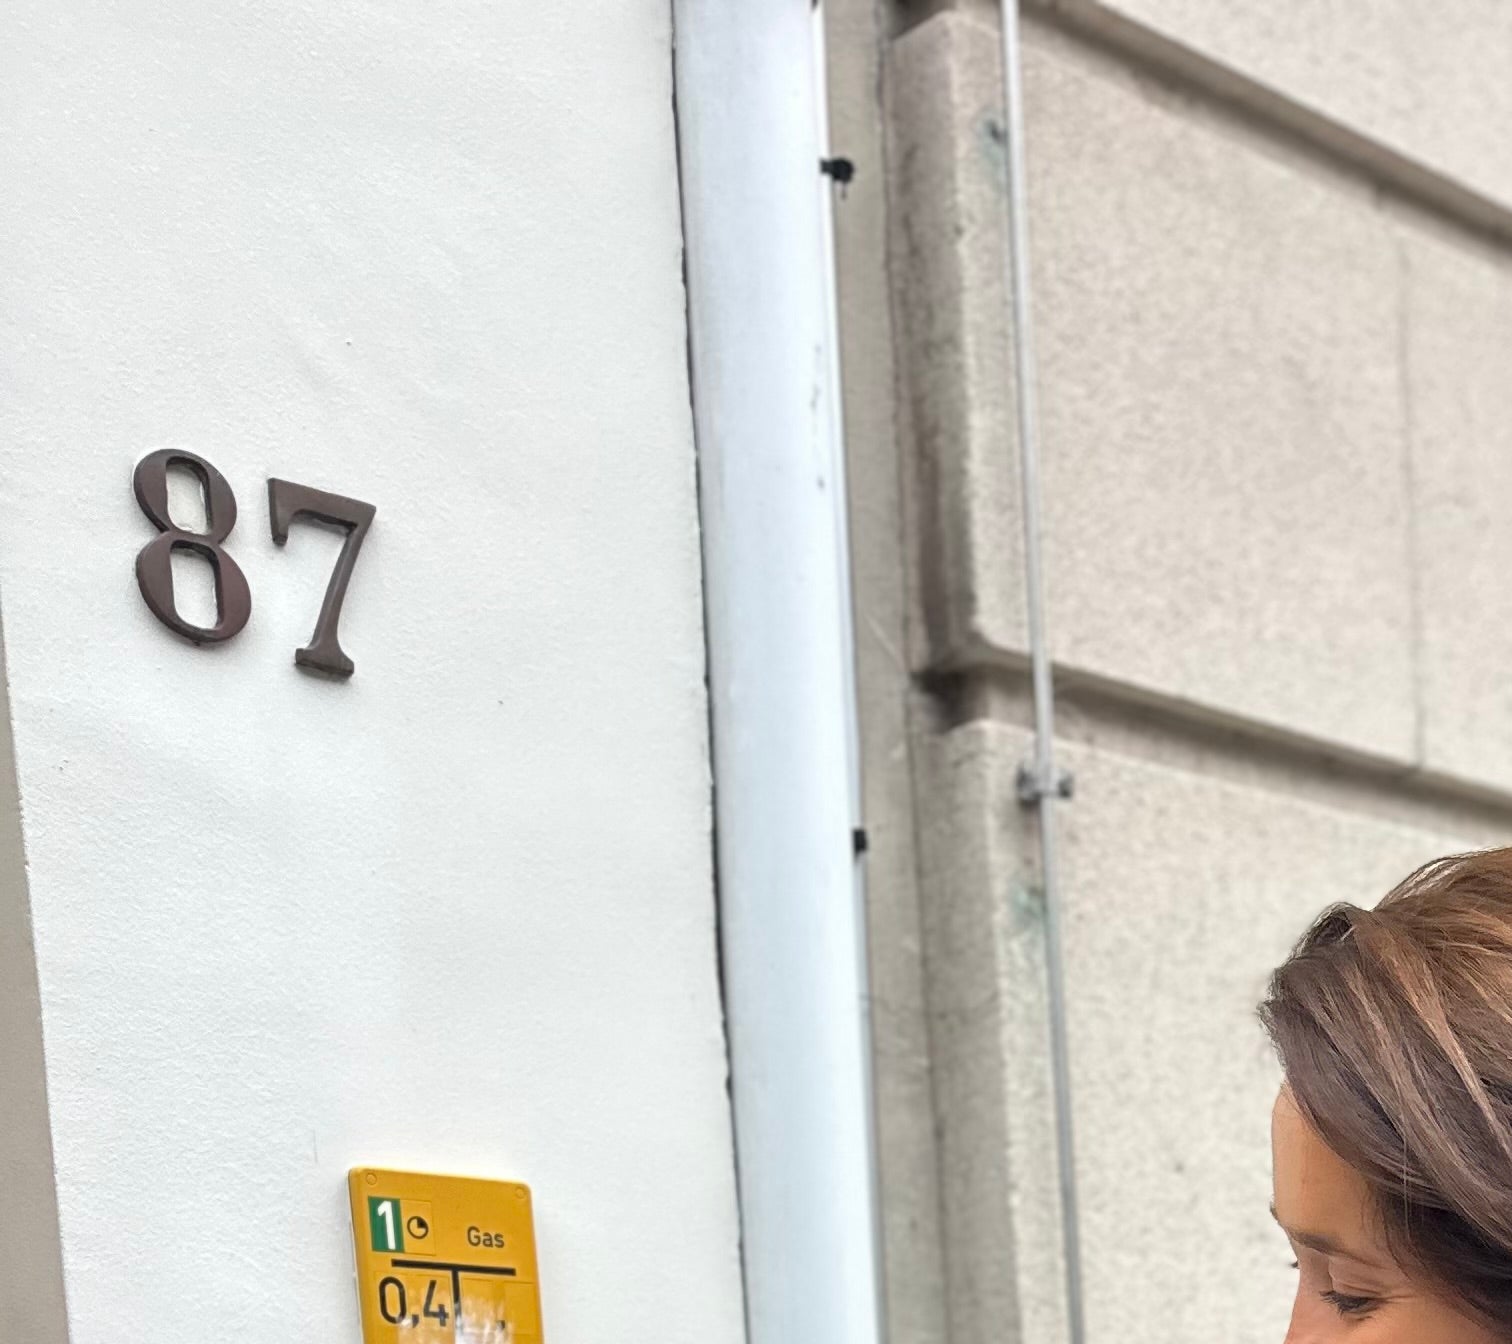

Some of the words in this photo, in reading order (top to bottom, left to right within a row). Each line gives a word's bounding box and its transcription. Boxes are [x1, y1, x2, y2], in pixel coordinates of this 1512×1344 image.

[132, 448, 377, 678] 87
[377, 1200, 396, 1250] 1
[467, 1226, 505, 1249] Gas
[378, 1276, 449, 1328] 0,4
